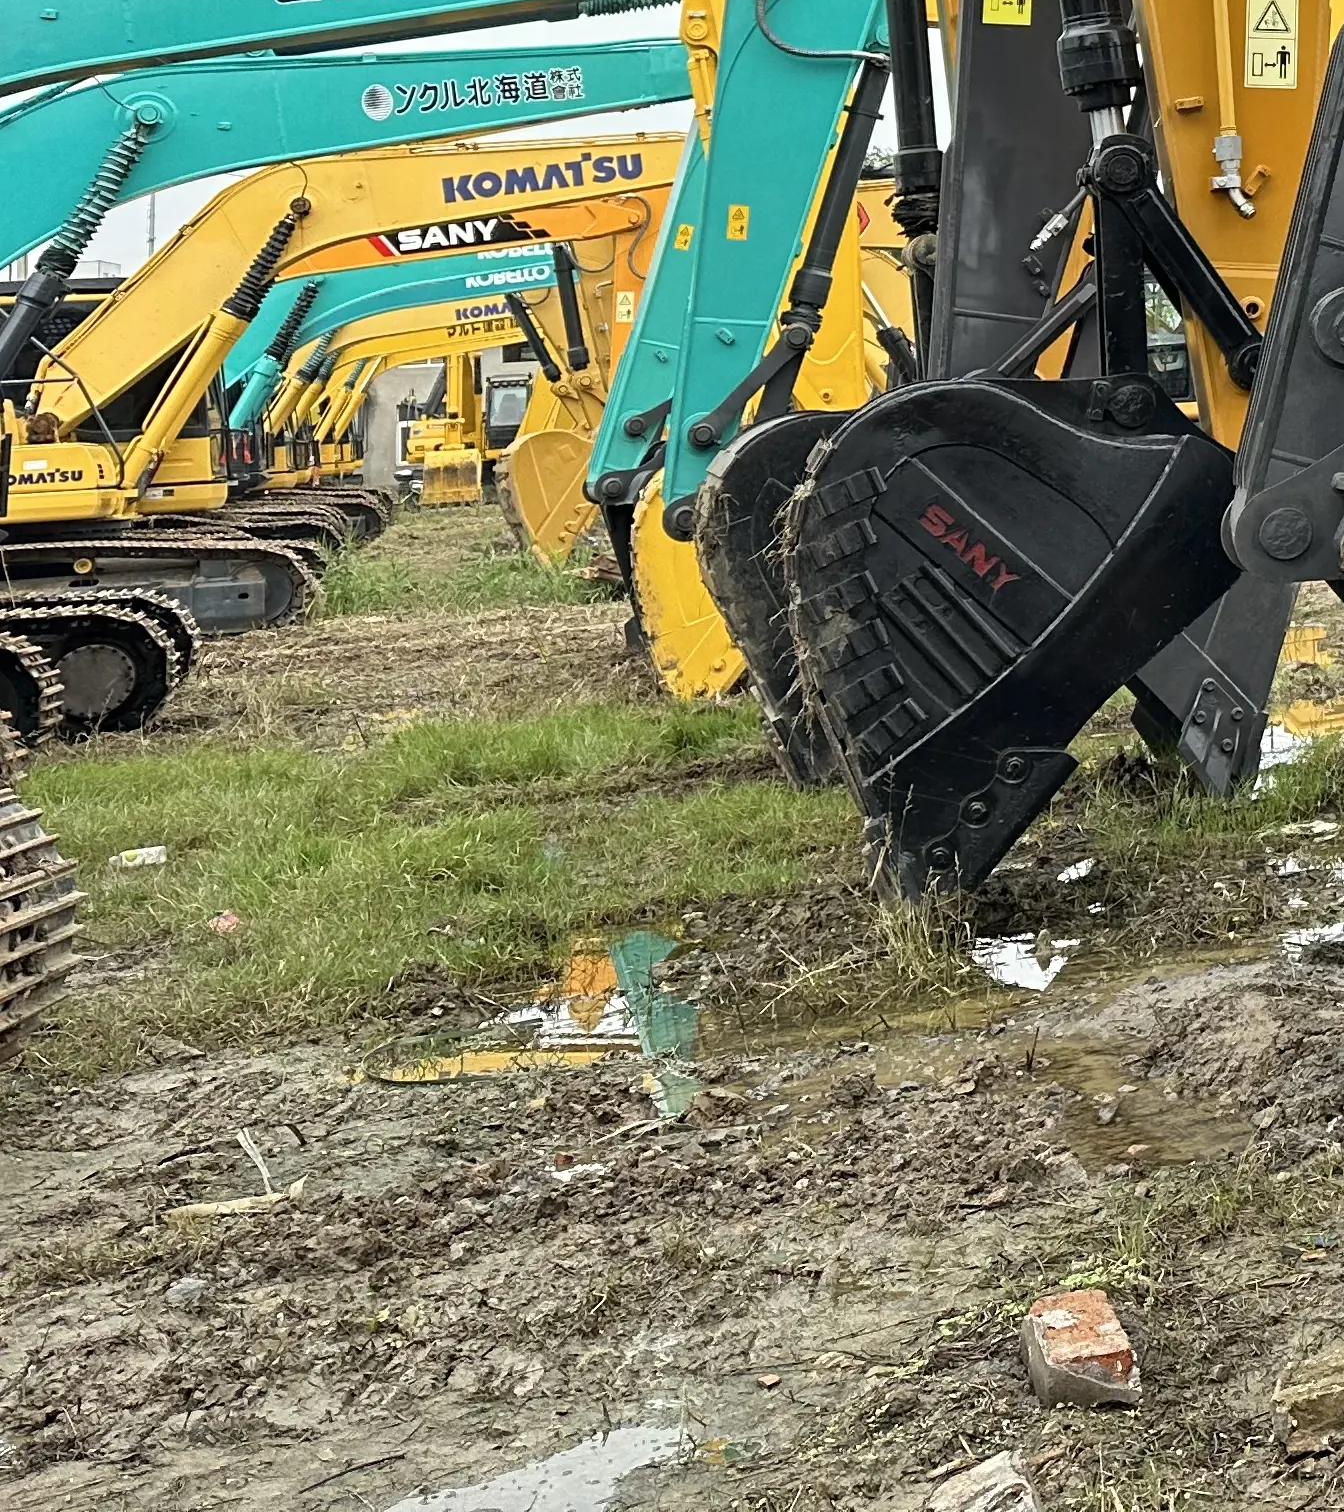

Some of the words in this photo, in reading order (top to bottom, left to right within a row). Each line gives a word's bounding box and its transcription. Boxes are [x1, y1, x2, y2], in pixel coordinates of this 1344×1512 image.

[441, 152, 643, 204] KOMATSU
[397, 218, 498, 251] SANY
[455, 303, 513, 321] KOMA
[6, 468, 84, 486] OMATSU
[918, 504, 1021, 592] SANY
